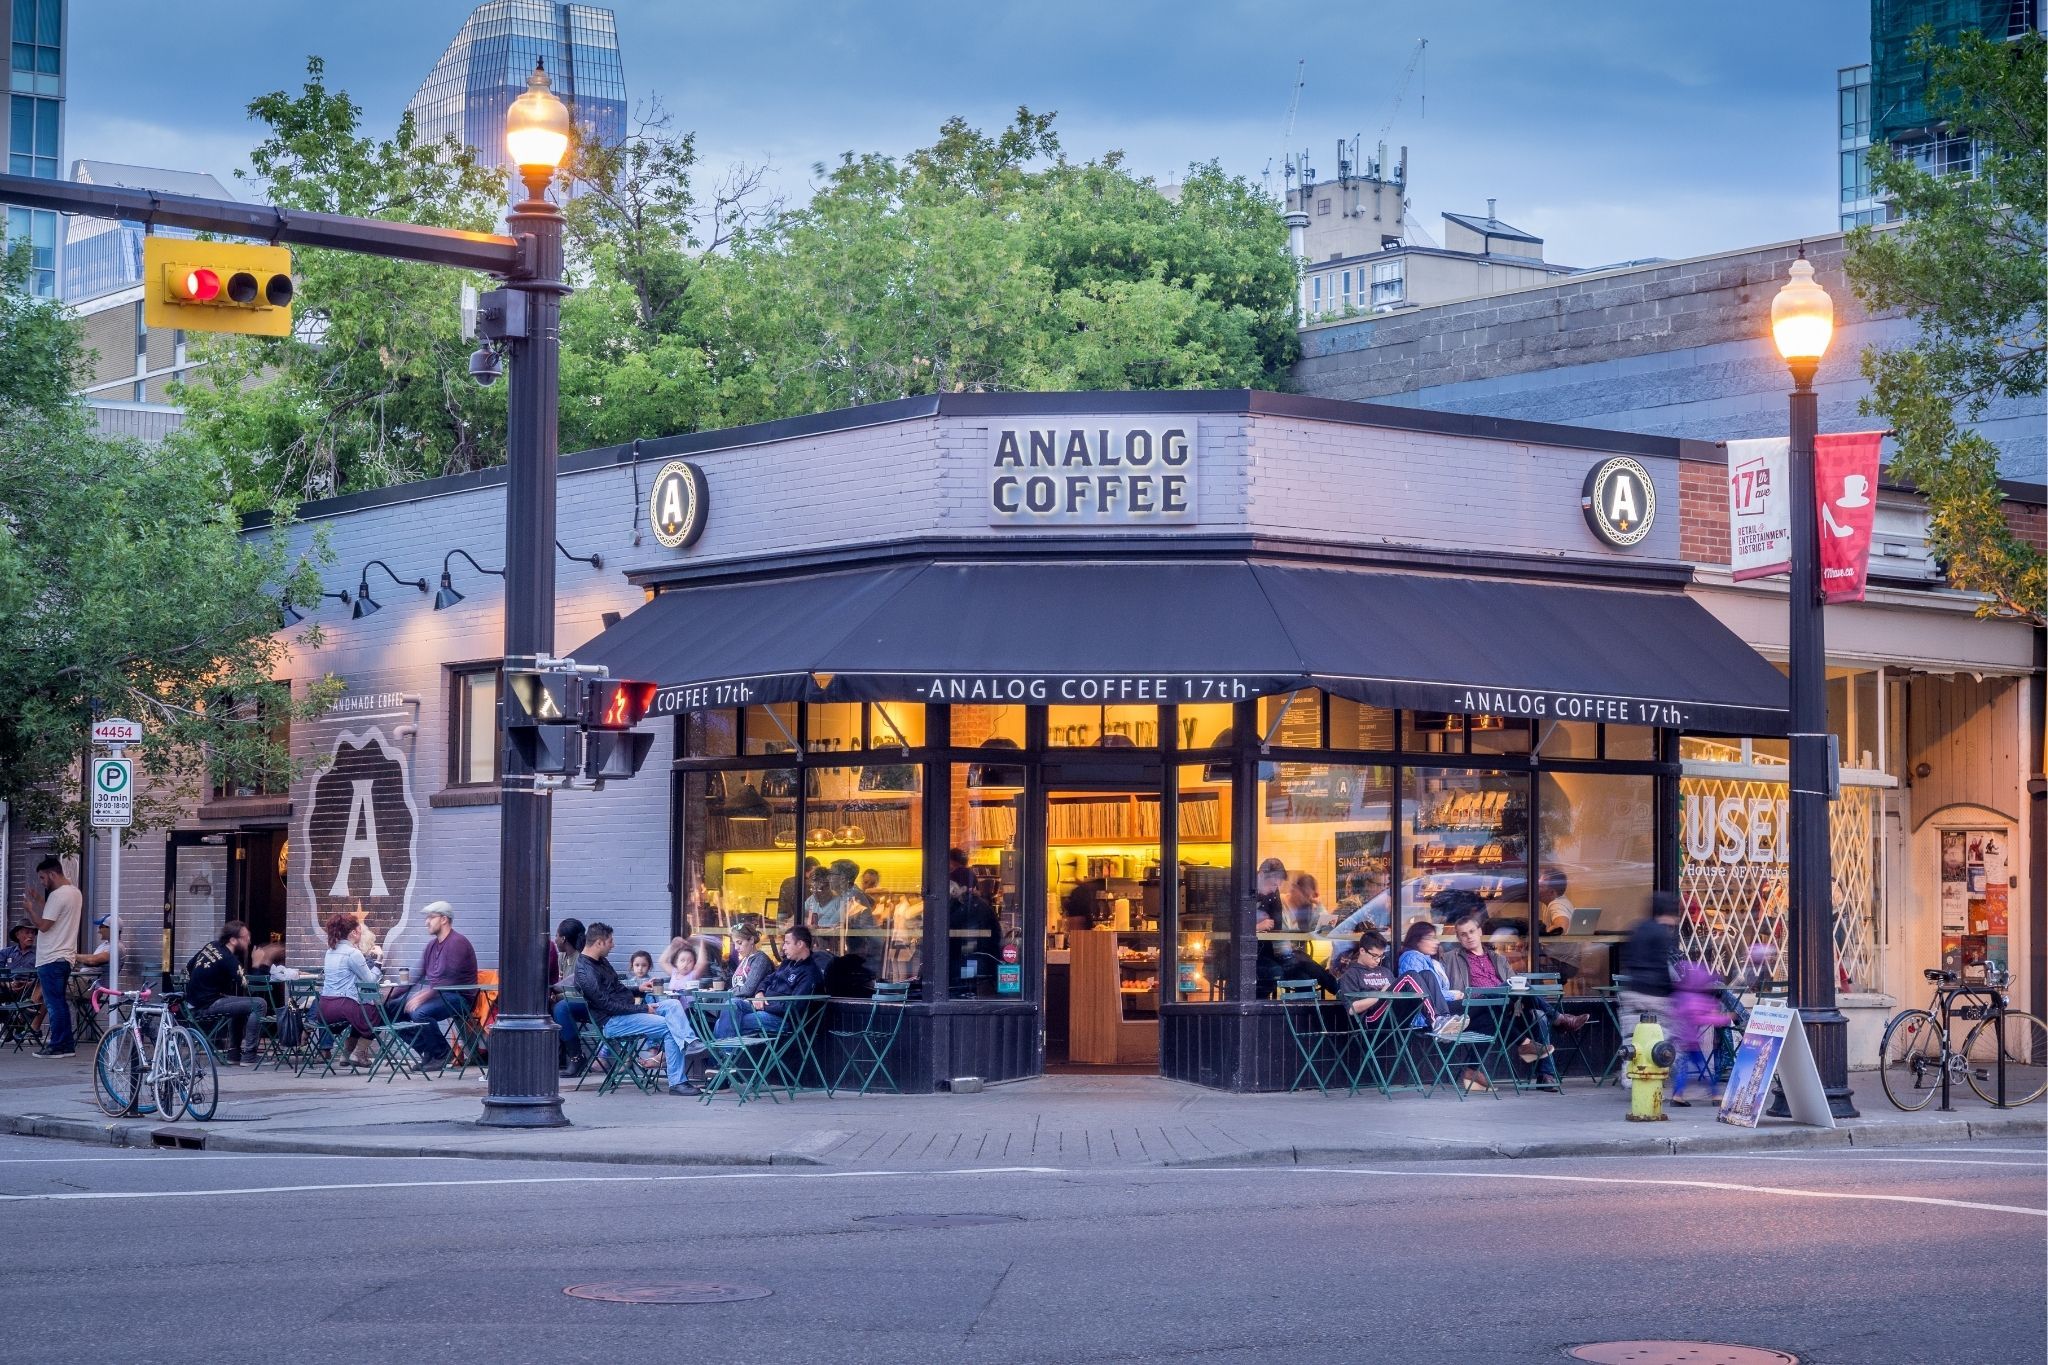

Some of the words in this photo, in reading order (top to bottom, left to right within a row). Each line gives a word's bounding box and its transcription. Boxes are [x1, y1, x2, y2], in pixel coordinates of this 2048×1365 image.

[994, 430, 1189, 466] ANALOG
[993, 475, 1188, 512] COFFEE
[1611, 476, 1638, 521] A
[1732, 471, 1754, 509] 17
[1755, 488, 1771, 498] ave
[662, 479, 682, 524] A
[1738, 525, 1757, 536] RETAIL
[1738, 529, 1787, 545] ENTERTAINMENT
[1739, 542, 1766, 555] DISTRICT
[1061, 679, 1168, 699] COFFEE
[657, 687, 709, 712] COFFEE
[1555, 697, 1629, 721] COFFEE
[101, 726, 133, 738] 4454
[97, 793, 109, 802] 30
[110, 793, 128, 802] min
[328, 779, 390, 897] A
[1338, 857, 1366, 867] SINGLE
[1686, 863, 1726, 877] House
